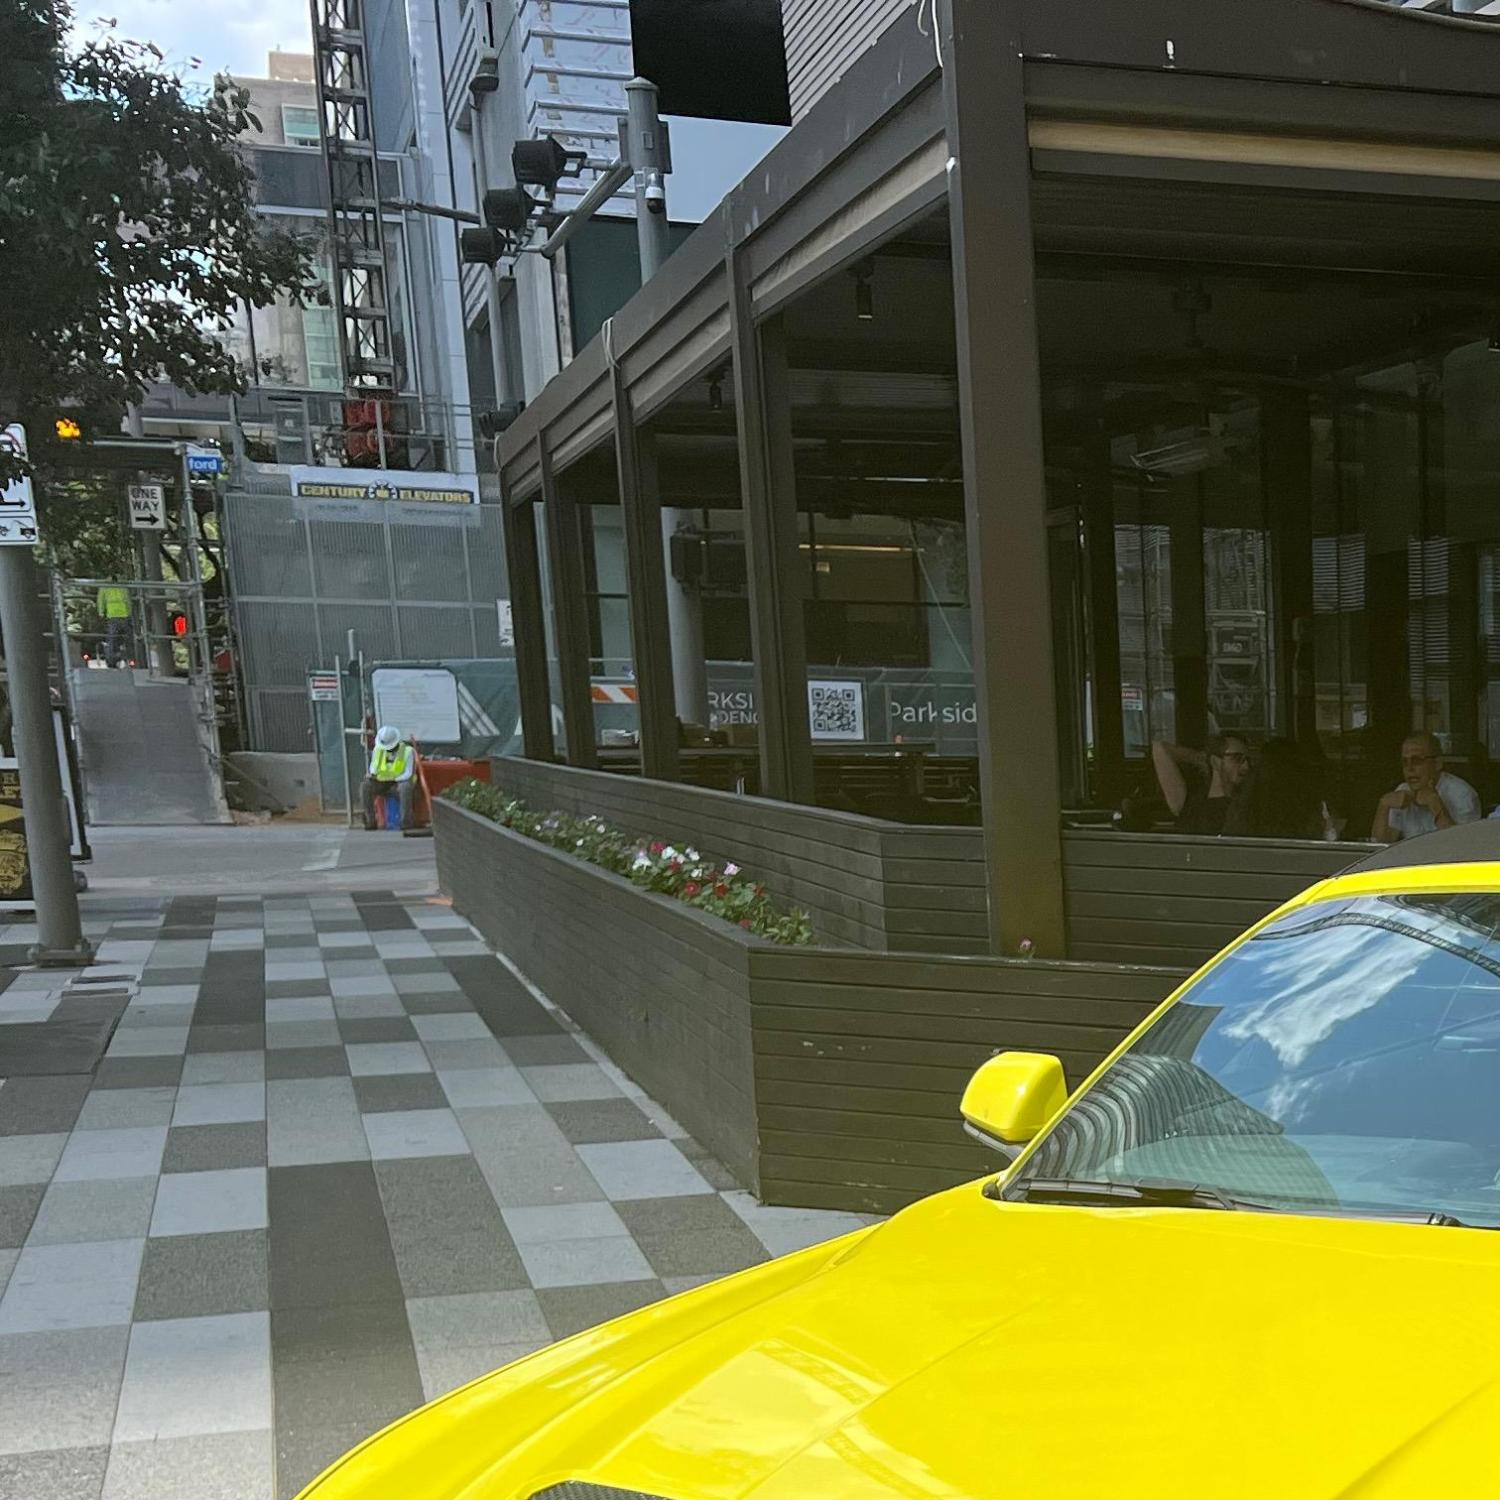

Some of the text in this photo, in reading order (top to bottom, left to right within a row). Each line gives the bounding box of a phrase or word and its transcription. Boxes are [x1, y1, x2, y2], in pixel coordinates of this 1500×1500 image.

[130, 488, 158, 499] ONE
[301, 485, 471, 504] CENTURY ELEVATORS
[132, 501, 159, 511] WAY
